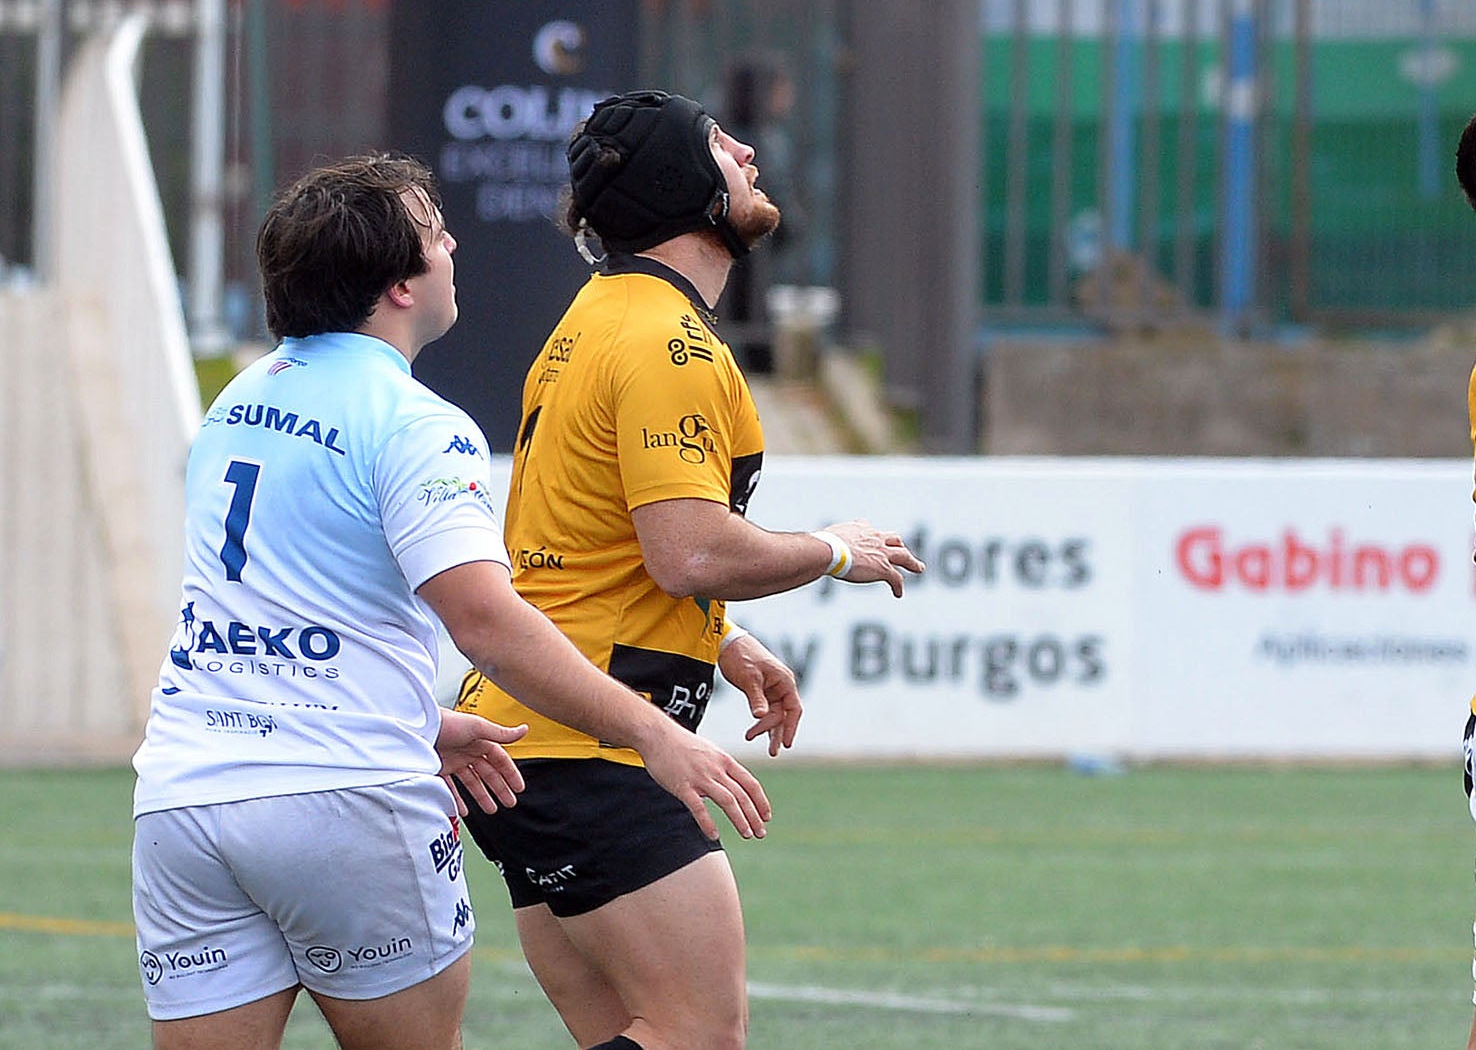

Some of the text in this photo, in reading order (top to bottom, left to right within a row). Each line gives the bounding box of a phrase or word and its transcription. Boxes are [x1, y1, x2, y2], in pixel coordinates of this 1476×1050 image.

[226, 404, 345, 456] SUMAL
[222, 459, 262, 583] 1
[1176, 528, 1440, 592] Gabino
[193, 658, 340, 680] LOGISTICS
[851, 621, 1106, 701] Burgos
[165, 946, 228, 971] Youin
[348, 937, 413, 962] Youin
